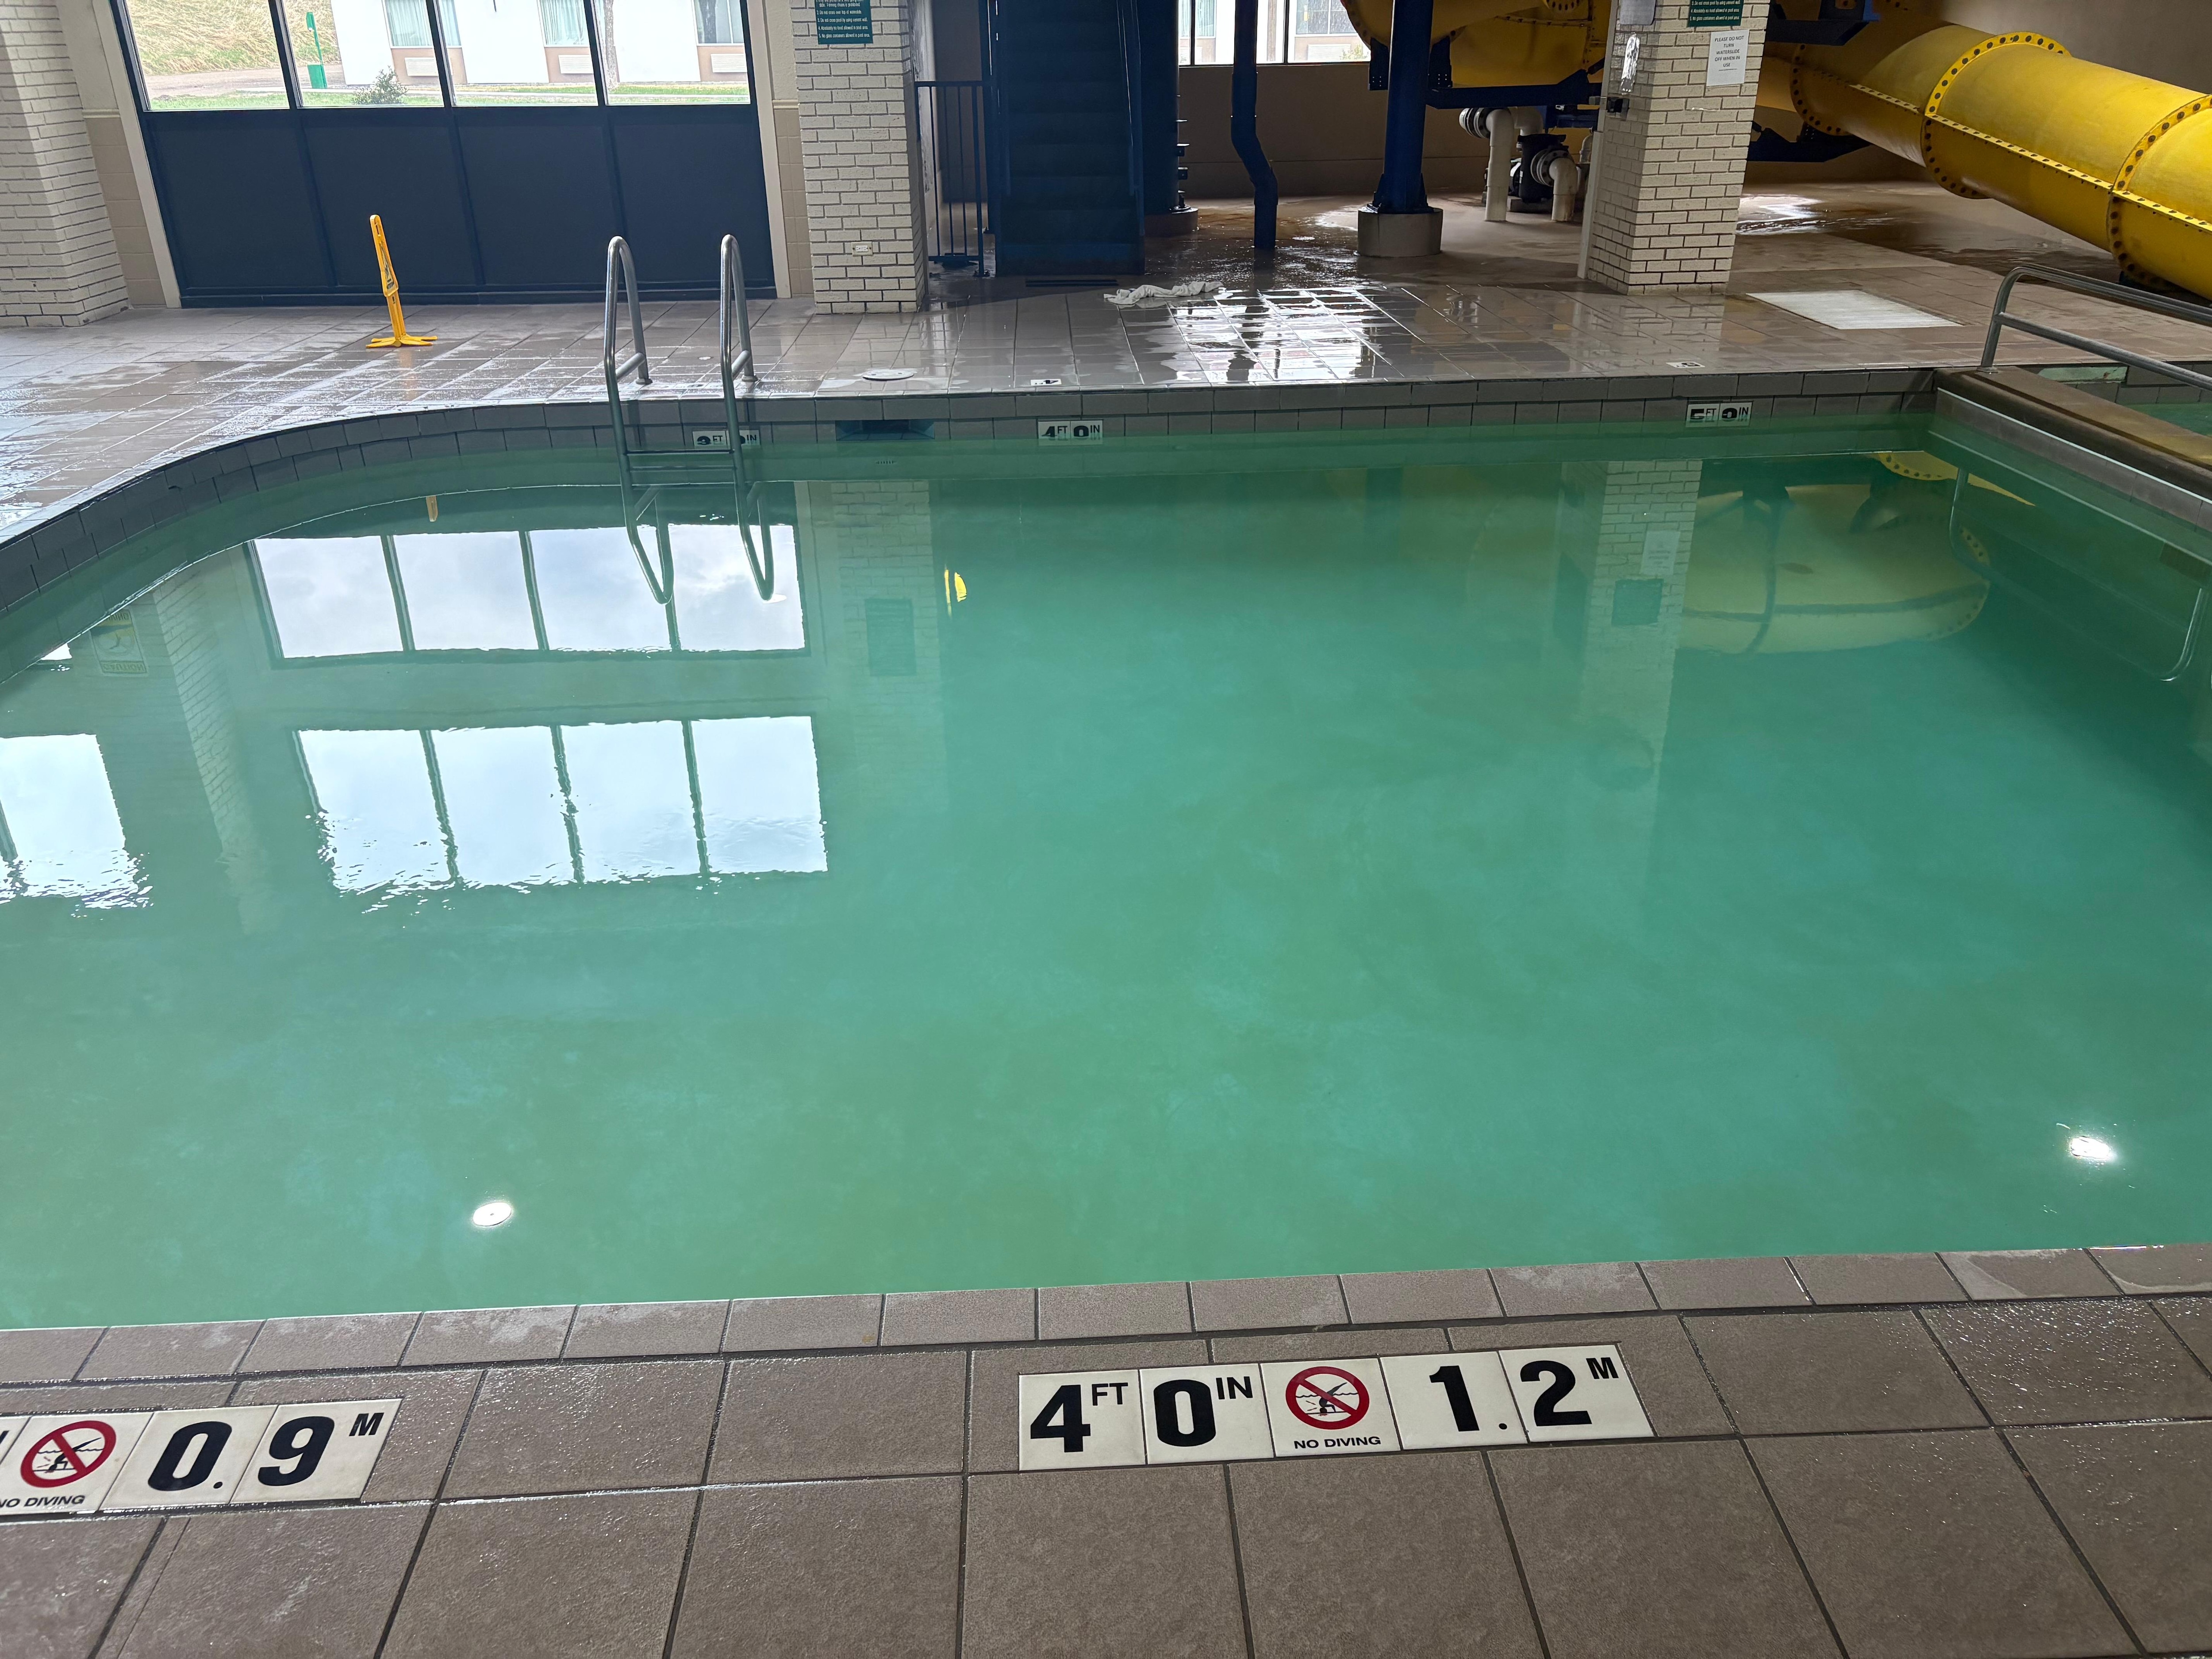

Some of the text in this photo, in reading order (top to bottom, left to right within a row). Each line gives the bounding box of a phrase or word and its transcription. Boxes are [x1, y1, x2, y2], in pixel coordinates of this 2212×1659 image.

[1690, 408, 1705, 420] 5
[1705, 408, 1717, 417] FT
[1739, 407, 1749, 416] IN
[1041, 426, 1057, 438] 4
[1090, 425, 1100, 433] IN
[1586, 1357, 1619, 1379] M
[1031, 1385, 1091, 1452] 4
[1091, 1382, 1128, 1406] FT
[1216, 1376, 1253, 1400] IN
[349, 1412, 384, 1436] M
[1294, 1436, 1381, 1449] NO DIVING
[24, 1495, 85, 1507] DIVING
